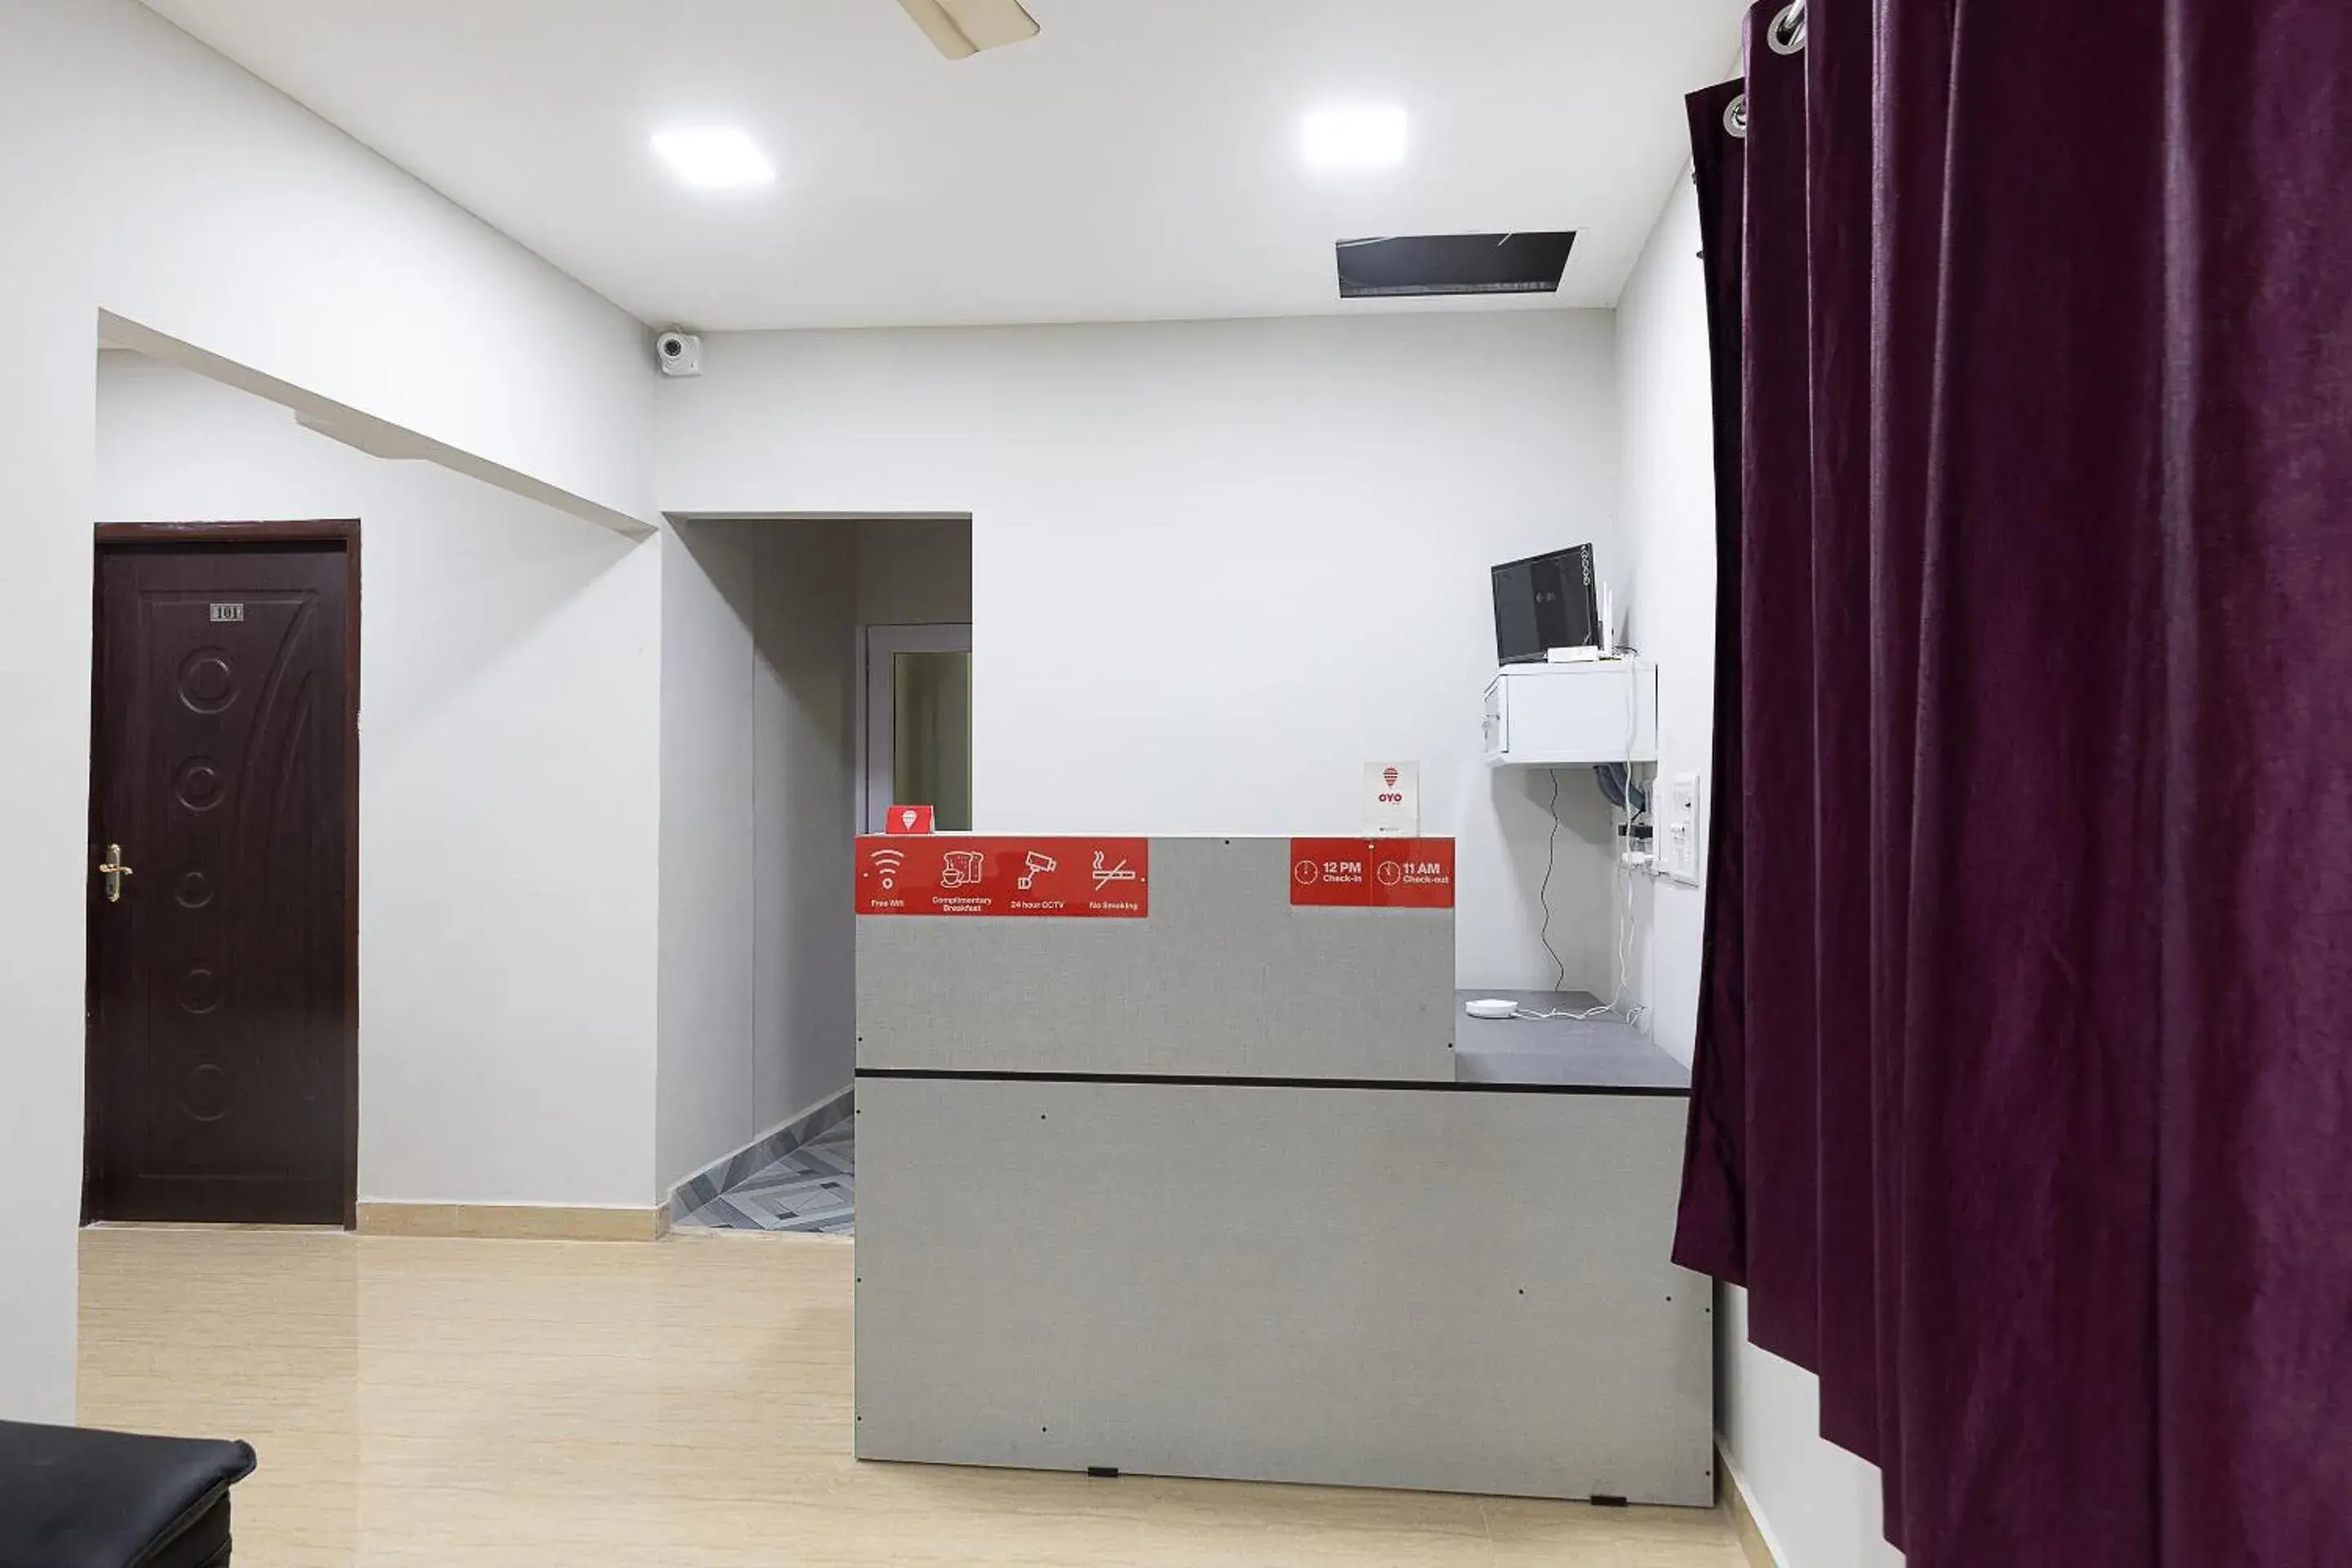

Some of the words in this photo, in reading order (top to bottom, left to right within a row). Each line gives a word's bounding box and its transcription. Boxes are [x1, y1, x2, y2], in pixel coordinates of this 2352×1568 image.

[218, 606, 238, 619] 101
[1379, 793, 1402, 802] OYO
[1323, 862, 1338, 873] 12
[1340, 862, 1361, 873] PM
[1403, 862, 1414, 874] 11
[1417, 862, 1440, 874] AM
[1323, 874, 1362, 882] Check-in
[1403, 875, 1449, 883] Check-out
[871, 899, 889, 907] Free
[933, 896, 992, 906] Complimentary
[1010, 901, 1022, 909] 24
[1042, 901, 1065, 909] CCTV
[943, 904, 982, 912] Breakfast
[1089, 901, 1102, 909] No
[1102, 901, 1138, 911] Smoking
